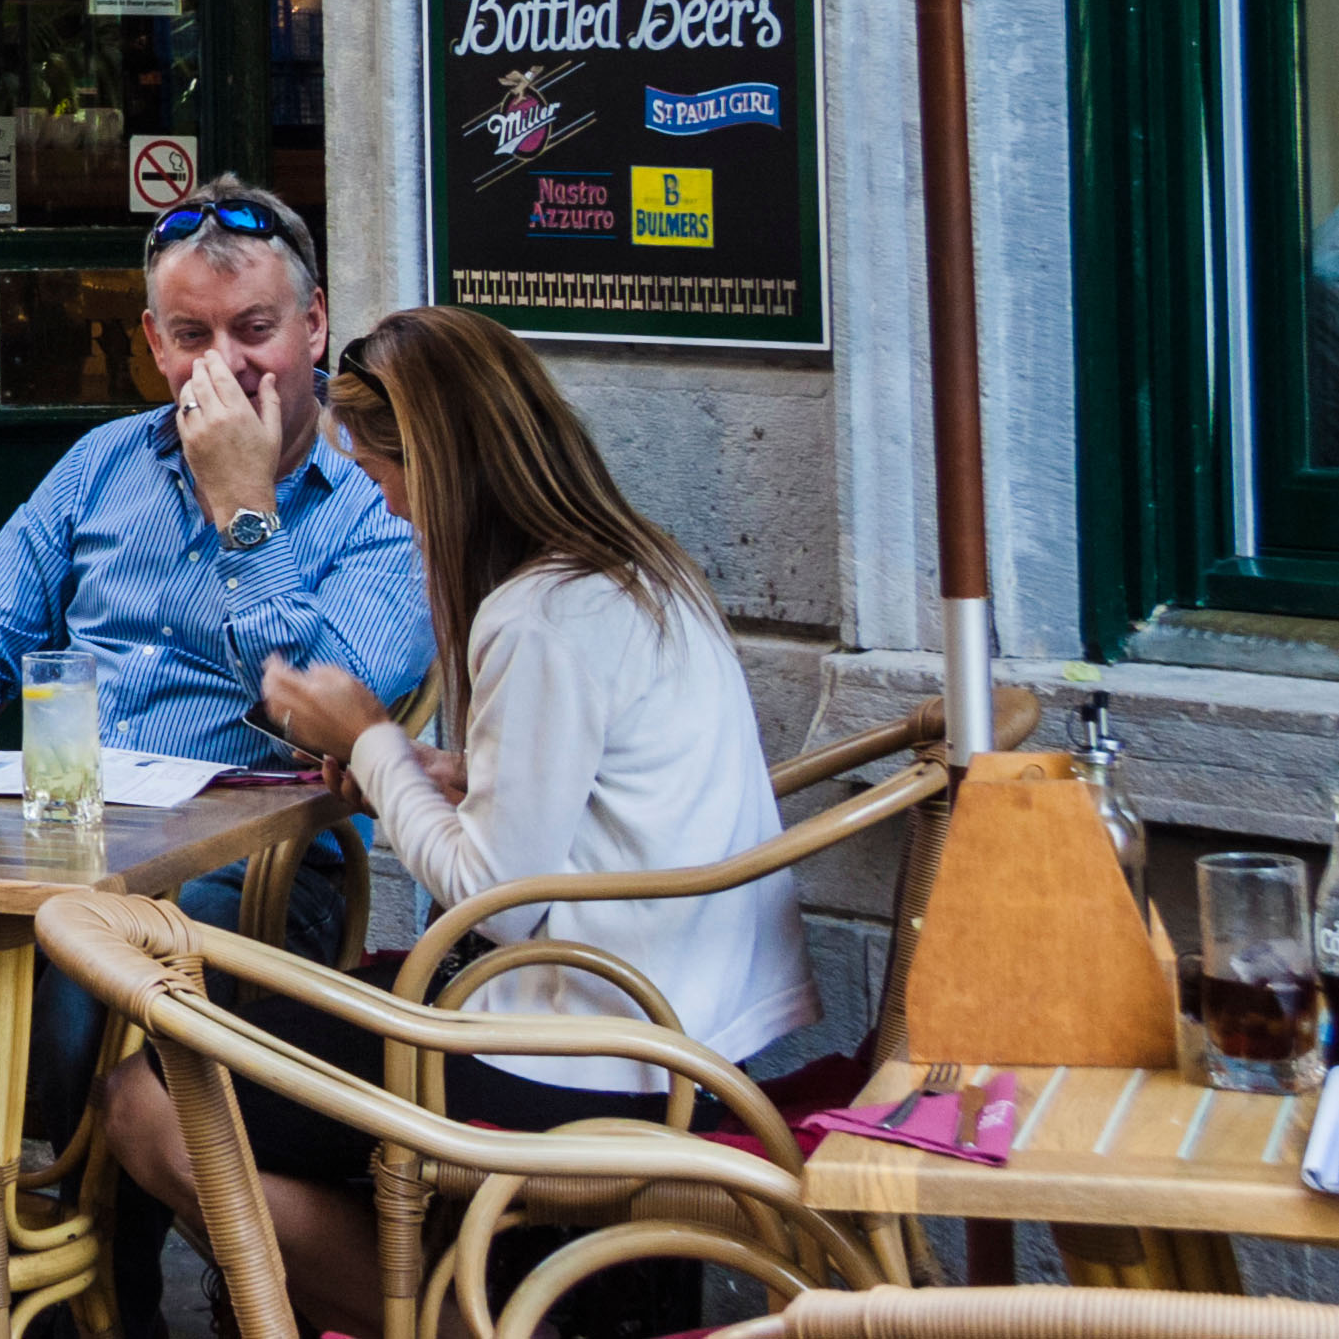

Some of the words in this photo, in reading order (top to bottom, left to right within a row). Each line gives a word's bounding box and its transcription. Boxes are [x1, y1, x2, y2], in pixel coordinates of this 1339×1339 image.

[675, 95, 727, 125] PAULI
[729, 91, 775, 115] GIRL
[487, 102, 562, 149] Miller
[538, 177, 608, 205] Nastro
[663, 173, 680, 206] B
[529, 201, 615, 229] Azzurro
[635, 208, 709, 238] BULMERS
